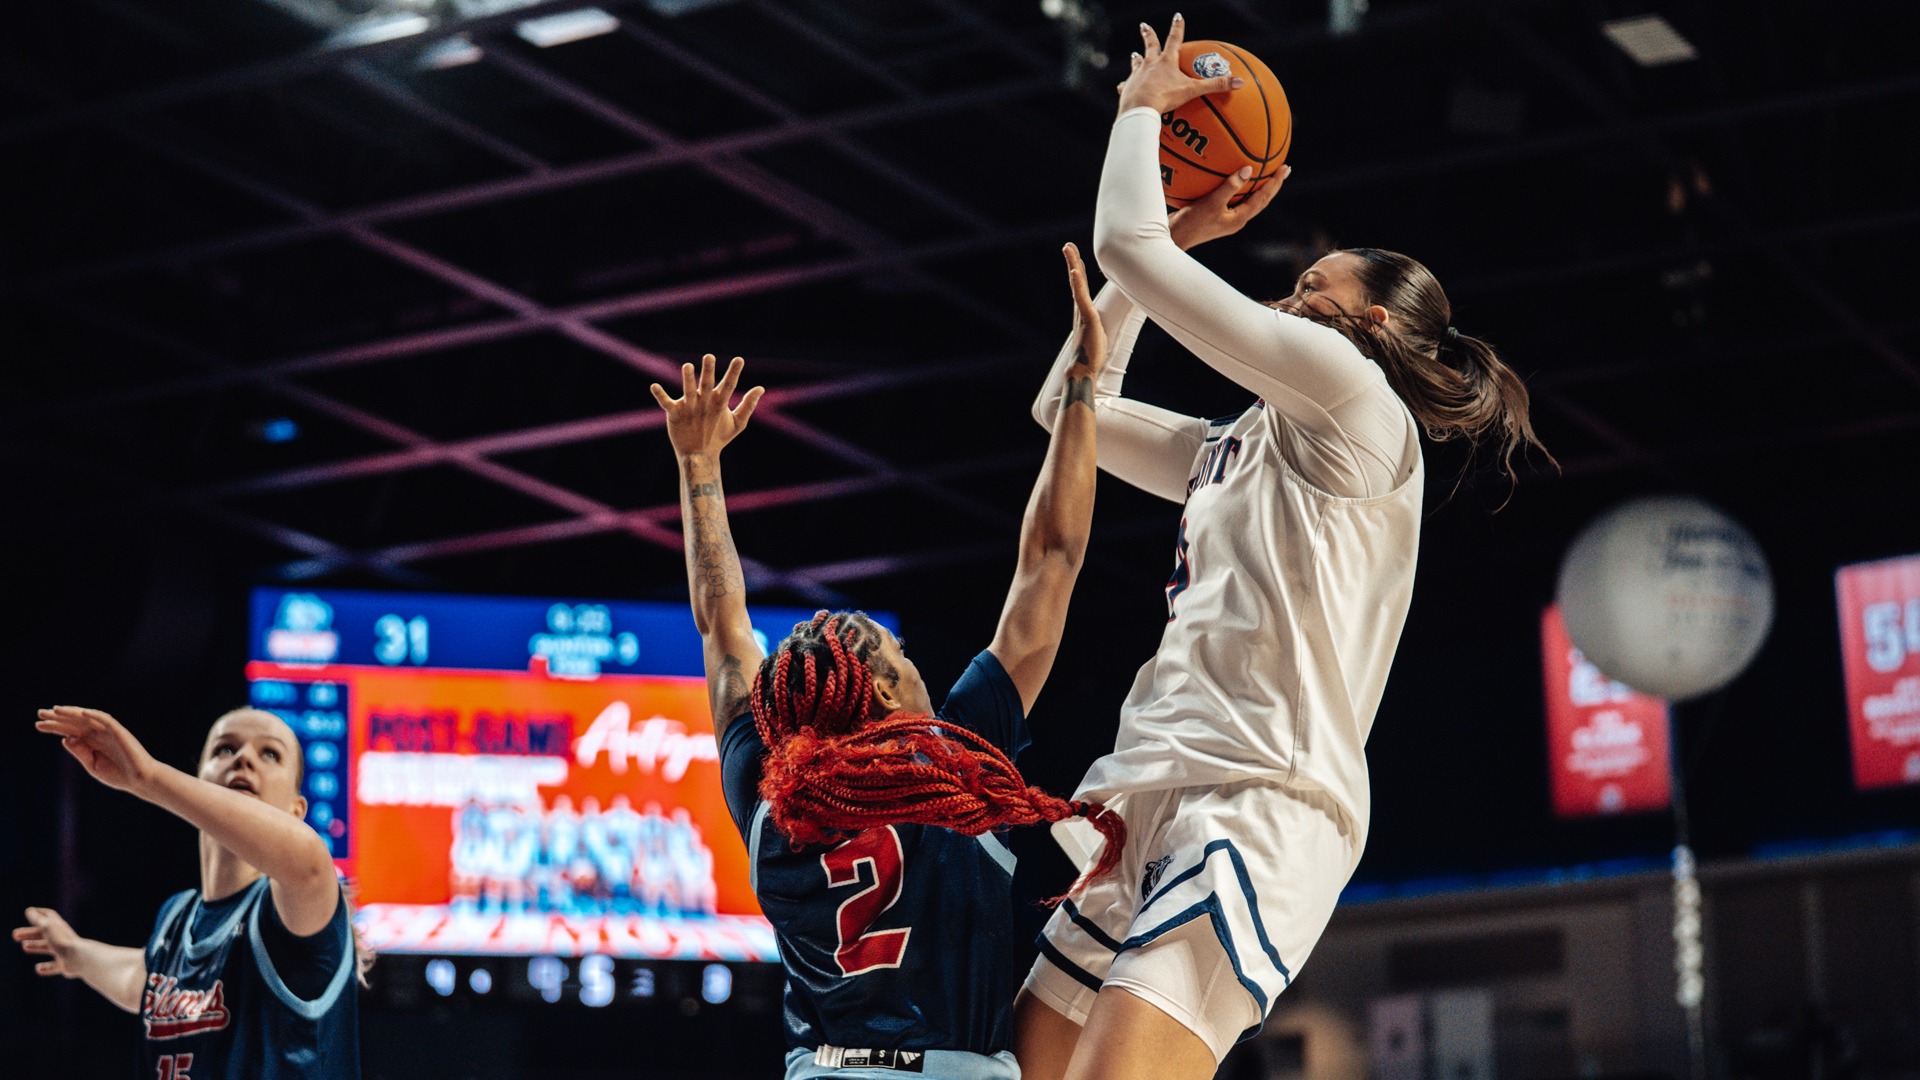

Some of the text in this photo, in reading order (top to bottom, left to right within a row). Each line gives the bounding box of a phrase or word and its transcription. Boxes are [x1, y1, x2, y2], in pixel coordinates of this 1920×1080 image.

[1160, 109, 1209, 156] son
[374, 613, 429, 666] 31
[820, 824, 912, 978] 2
[879, 1050, 886, 1058] S
